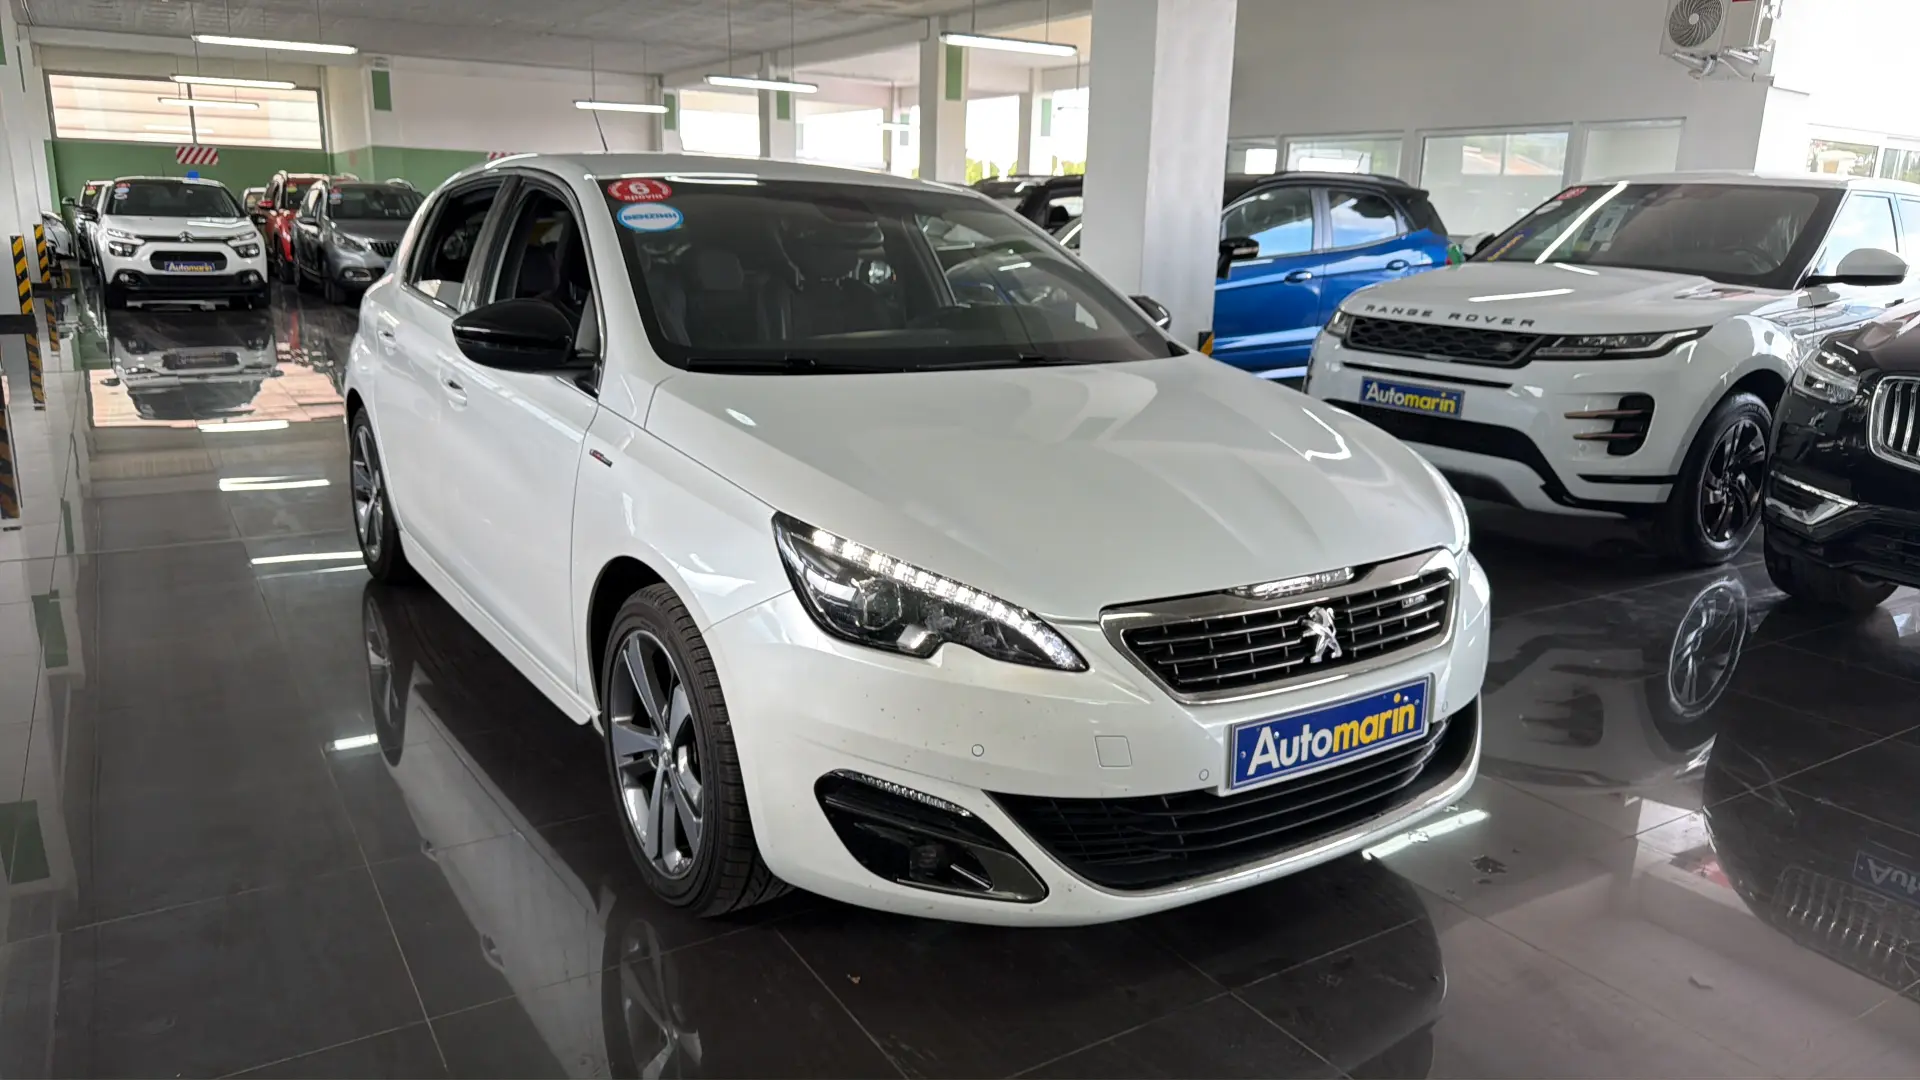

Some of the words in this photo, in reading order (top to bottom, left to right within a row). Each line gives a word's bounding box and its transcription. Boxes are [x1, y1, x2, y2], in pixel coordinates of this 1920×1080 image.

[628, 182, 650, 195] 6
[1365, 304, 1433, 317] RANGE
[1448, 312, 1535, 327] ROVER
[1365, 381, 1456, 413] Automarin
[1247, 692, 1416, 775] Automarin
